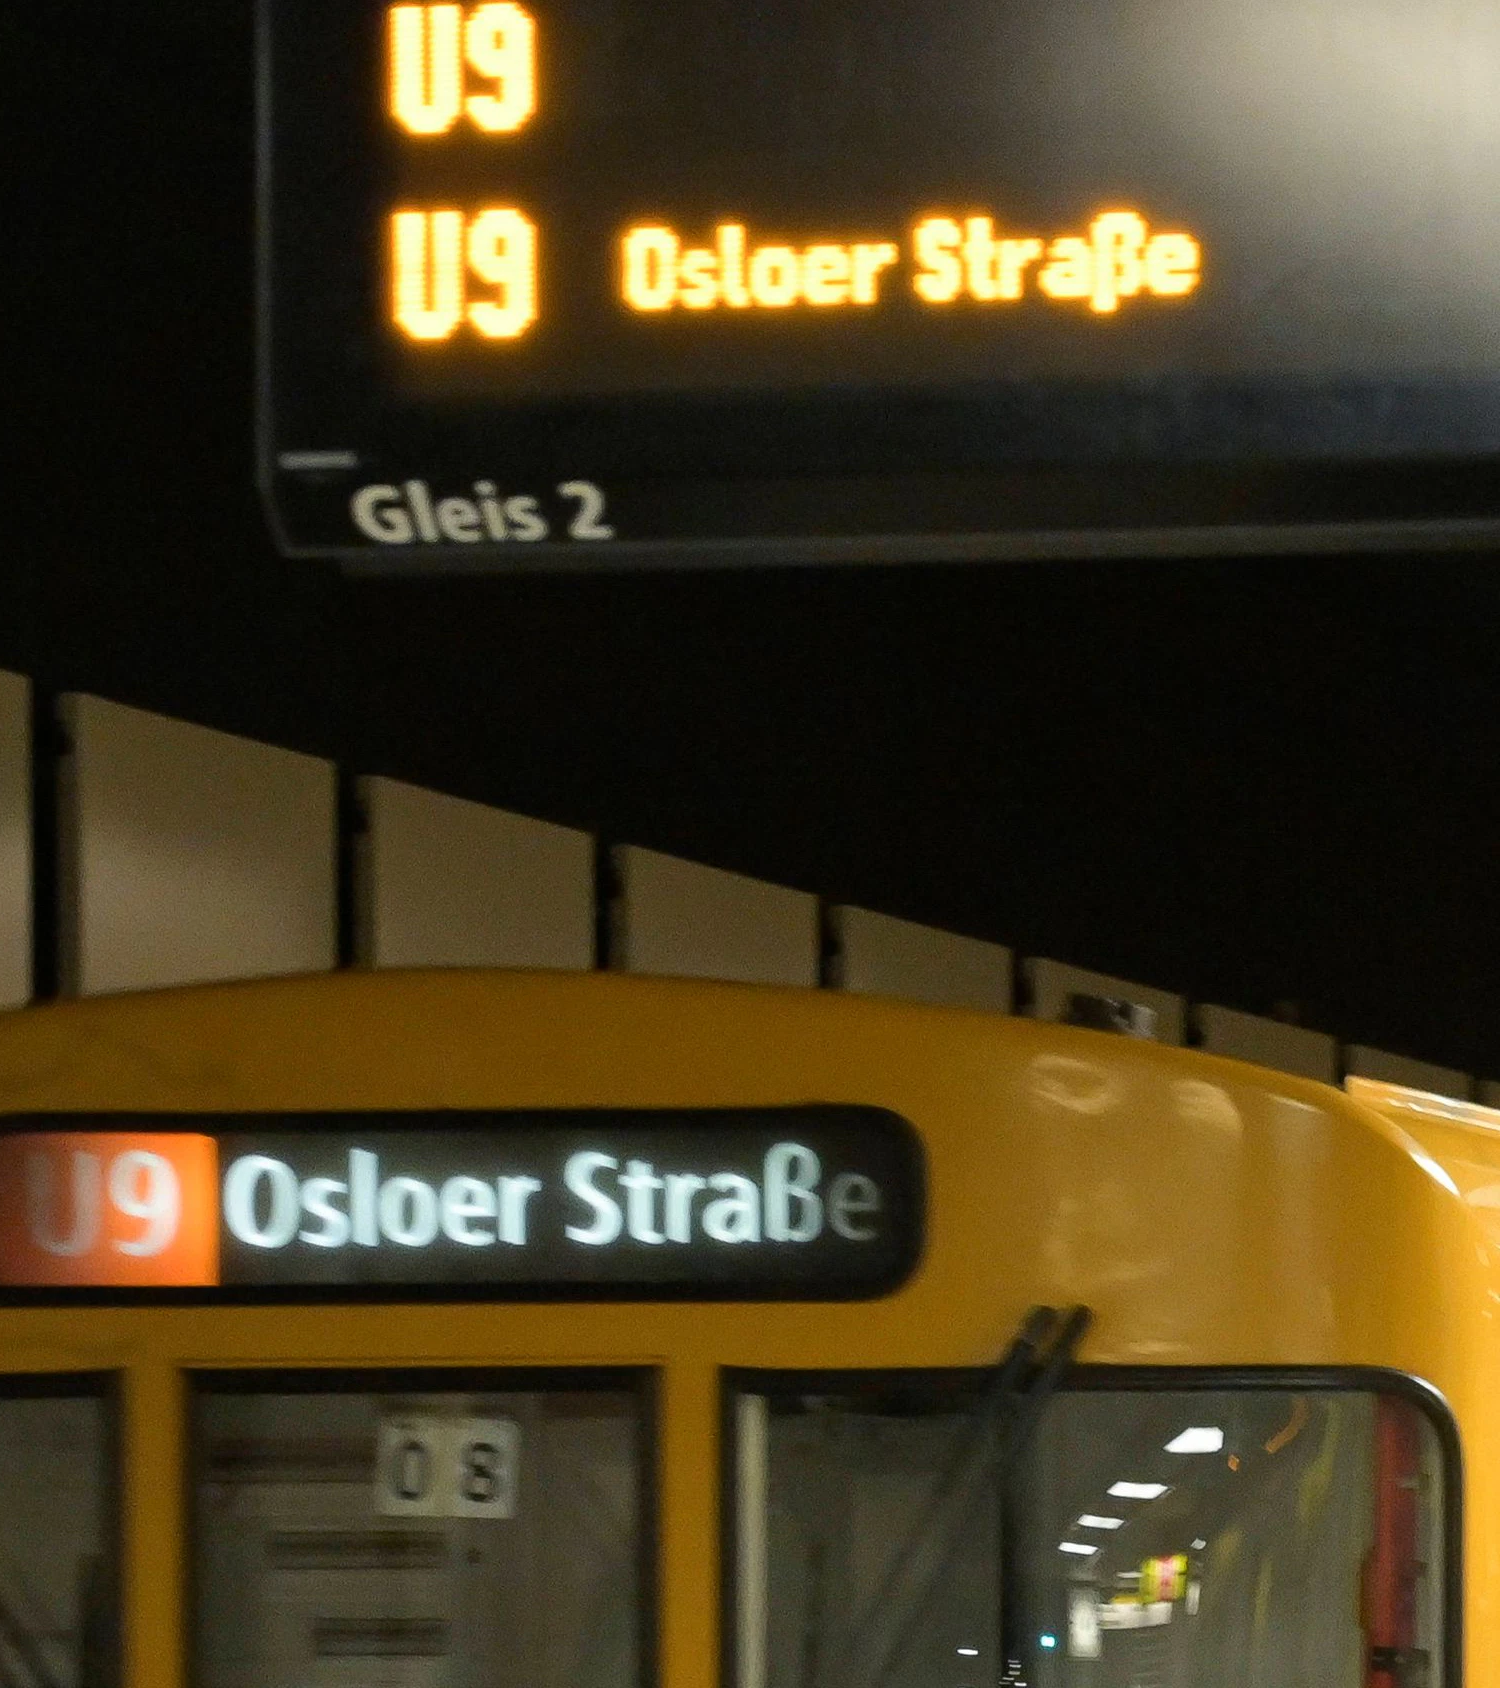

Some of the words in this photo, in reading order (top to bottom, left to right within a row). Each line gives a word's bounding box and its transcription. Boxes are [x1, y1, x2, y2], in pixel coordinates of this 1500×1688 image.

[388, 2, 538, 135] U9
[389, 207, 539, 341] U9
[619, 223, 900, 312] Osloer
[910, 210, 1202, 315] Straße
[352, 480, 548, 544] Gleis
[559, 480, 613, 541] 2
[23, 1147, 183, 1259] U9
[220, 1147, 543, 1250] Osloer
[562, 1141, 884, 1248] Straße
